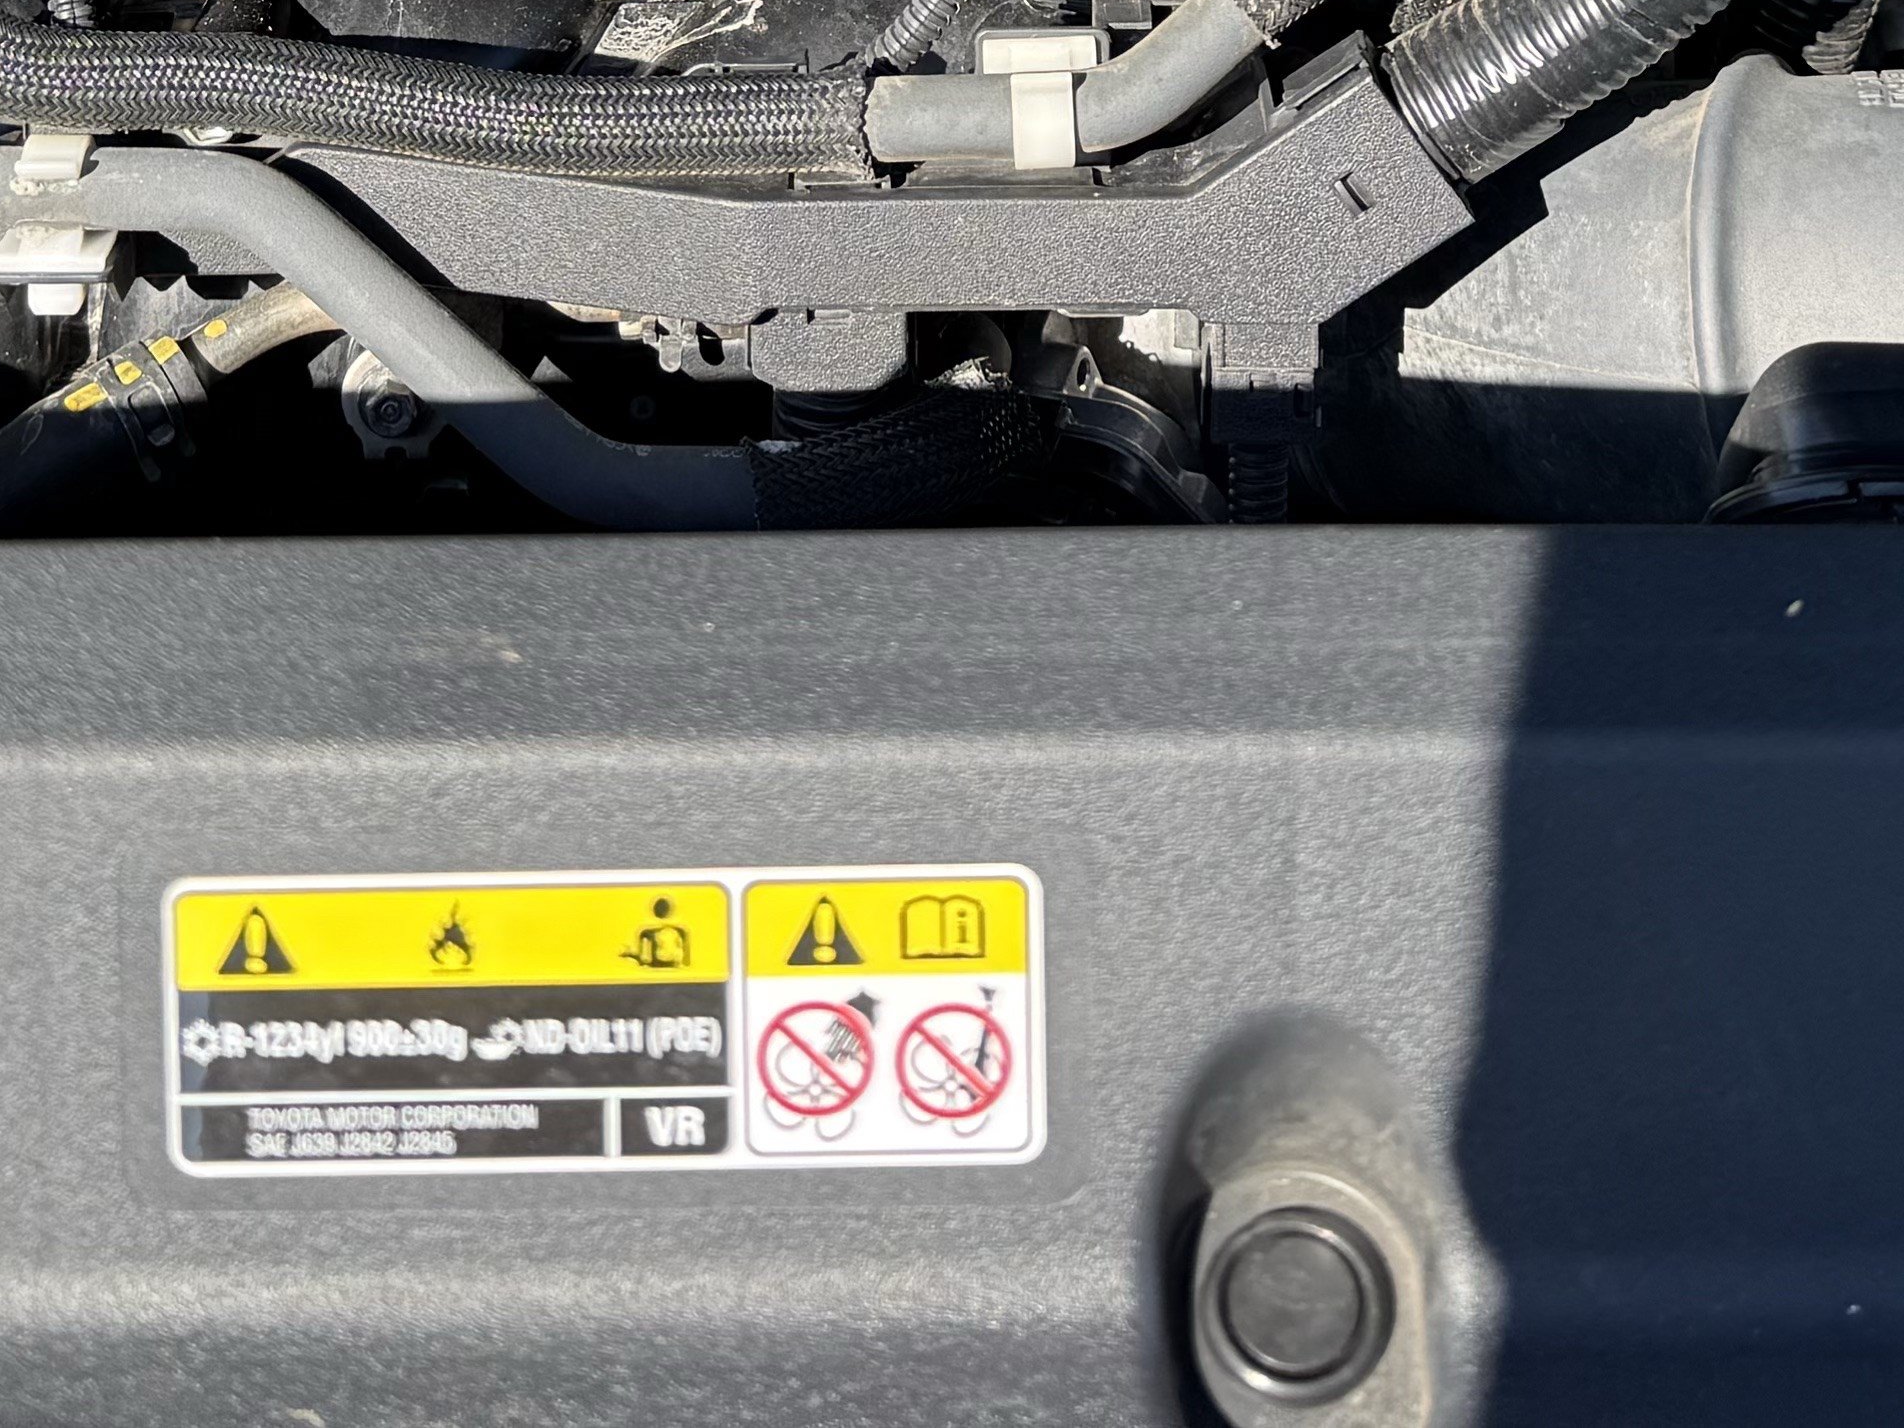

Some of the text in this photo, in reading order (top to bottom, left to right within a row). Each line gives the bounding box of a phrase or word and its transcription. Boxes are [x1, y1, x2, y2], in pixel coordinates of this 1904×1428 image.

[246, 1102, 540, 1131] TOYOTA MOTOR CORPORATION
[642, 1104, 707, 1147] VR
